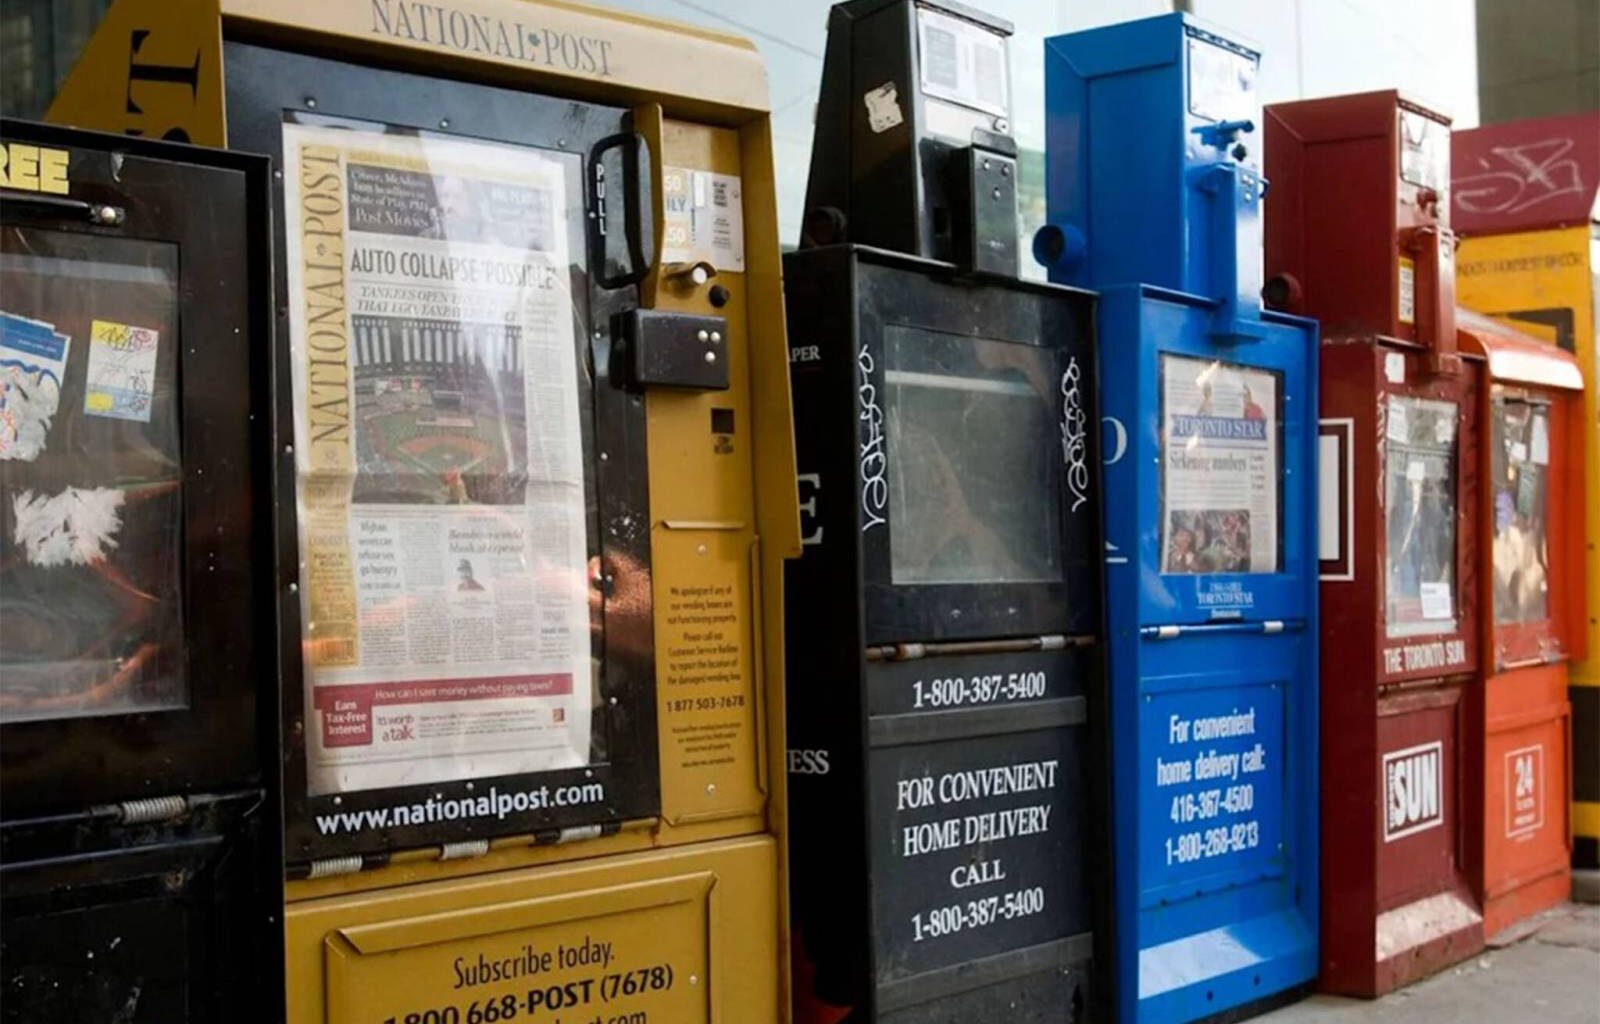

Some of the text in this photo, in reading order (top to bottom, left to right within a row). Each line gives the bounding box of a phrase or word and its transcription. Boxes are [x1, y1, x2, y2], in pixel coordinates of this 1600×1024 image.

[371, 0, 613, 76] NATIONAL POST
[302, 146, 343, 237] POST
[596, 163, 607, 236] PULL
[666, 198, 687, 212] ILY
[351, 248, 396, 275] AUTO
[400, 251, 479, 283] COLLAPSE
[305, 252, 349, 444] NATIONAL
[791, 345, 822, 362] PER
[1178, 418, 1264, 438] TORONTO STAR
[1383, 640, 1466, 675] THE TORONTO SUN
[334, 700, 358, 712] Earn
[674, 699, 694, 713] 877
[912, 671, 1046, 709] 1-800-387-5400
[1169, 706, 1256, 744] For convenient
[788, 750, 831, 775] ESS
[1156, 757, 1192, 787] home
[1194, 749, 1240, 781] delivery
[1515, 754, 1535, 799] 24
[896, 760, 1059, 811] FOR CONVENIENT
[1169, 783, 1255, 824] 416-367-4500
[1394, 751, 1438, 828] SUN
[316, 783, 605, 836] www.nationalpost.com
[902, 804, 1052, 857] HOME DELIVERY
[949, 858, 1007, 889] CALL
[911, 886, 1045, 942] 1-800-387-5400
[453, 935, 615, 989] Subscribe today.
[467, 979, 595, 1024] 668-POST
[599, 963, 673, 1003] (7678)
